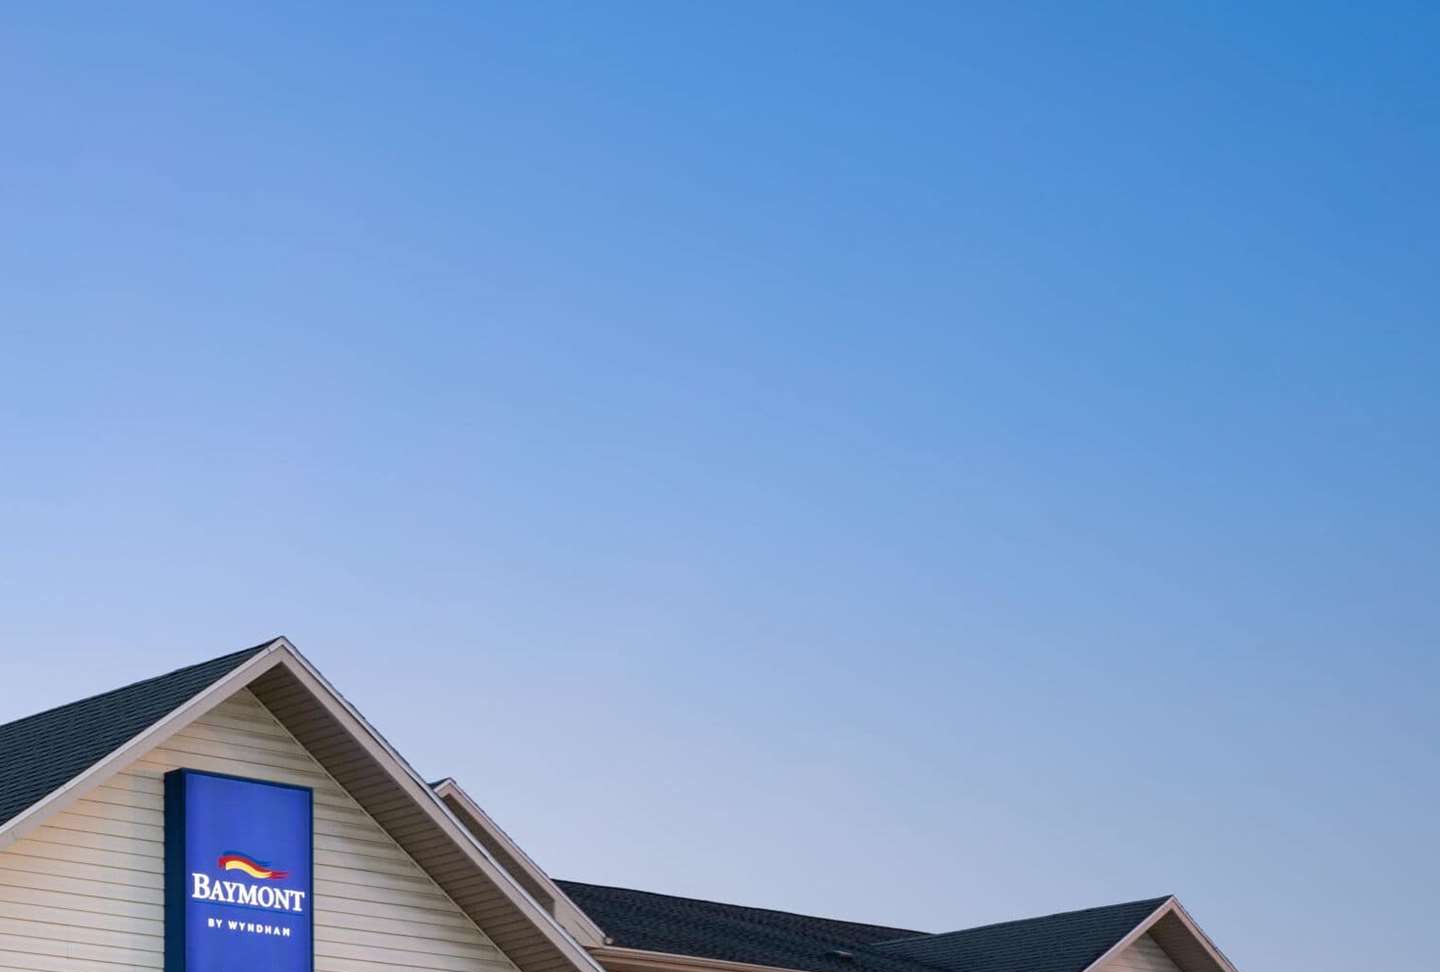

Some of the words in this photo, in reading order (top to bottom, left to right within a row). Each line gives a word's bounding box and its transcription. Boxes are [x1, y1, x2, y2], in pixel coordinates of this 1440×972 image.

[192, 873, 305, 912] BAYMONT
[208, 918, 222, 929] BY
[228, 921, 291, 937] WYNDHAM
